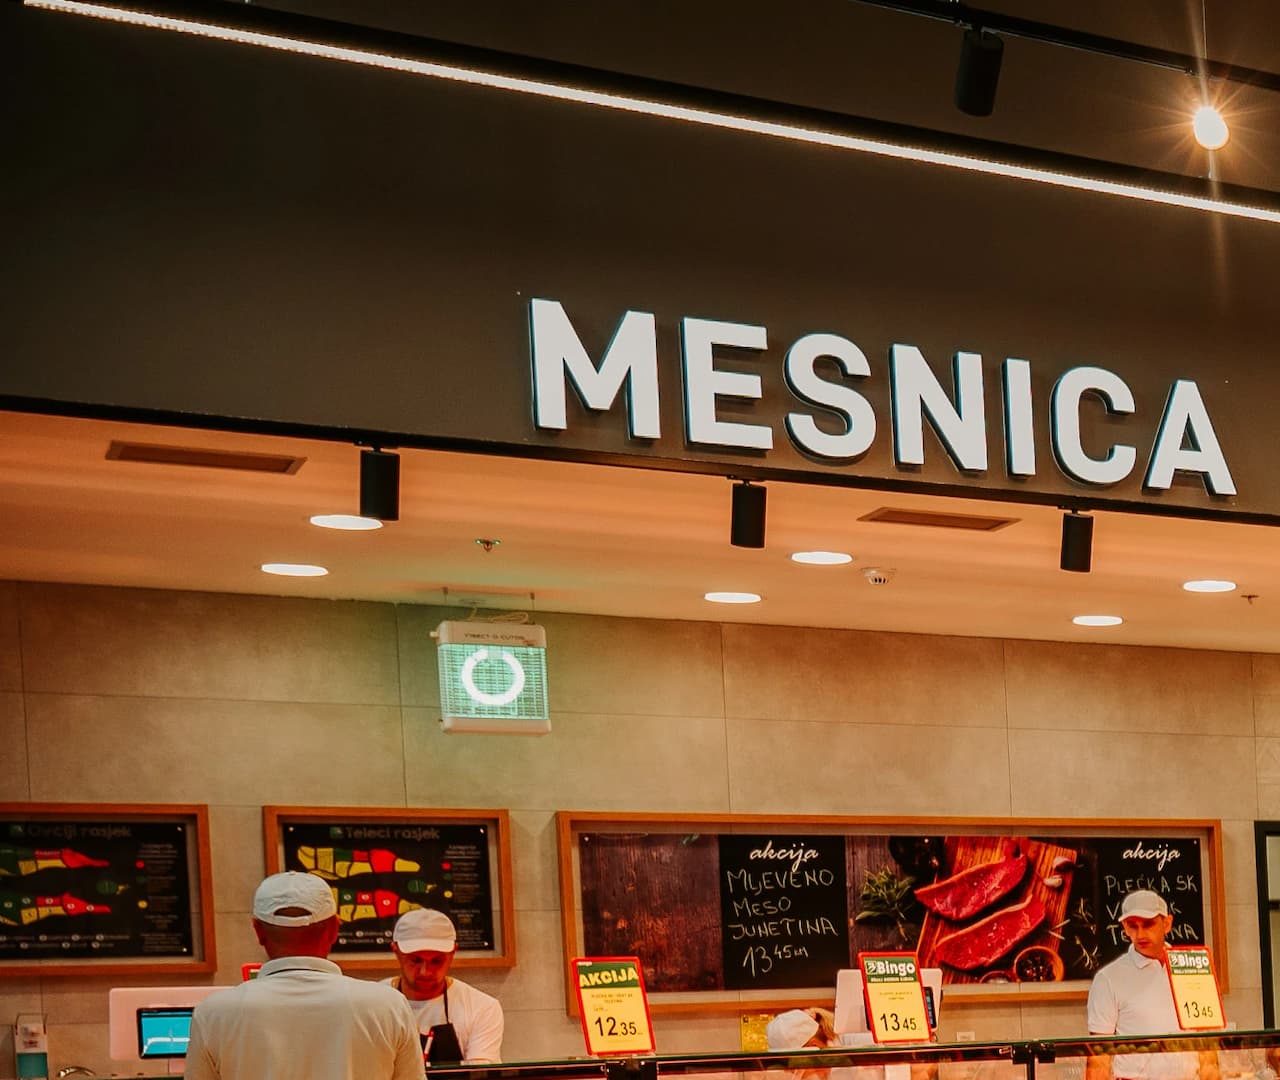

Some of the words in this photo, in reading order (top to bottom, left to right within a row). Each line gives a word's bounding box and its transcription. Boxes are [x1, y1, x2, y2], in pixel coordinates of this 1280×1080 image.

[529, 297, 1237, 497] MESNICA
[750, 840, 819, 872] akcija
[1123, 841, 1180, 871] akcija
[733, 896, 791, 918] MESO
[728, 917, 839, 940] JUNETINA
[877, 960, 915, 976] Bingo
[1179, 953, 1209, 969] Bingo
[579, 967, 639, 987] AKCIJA
